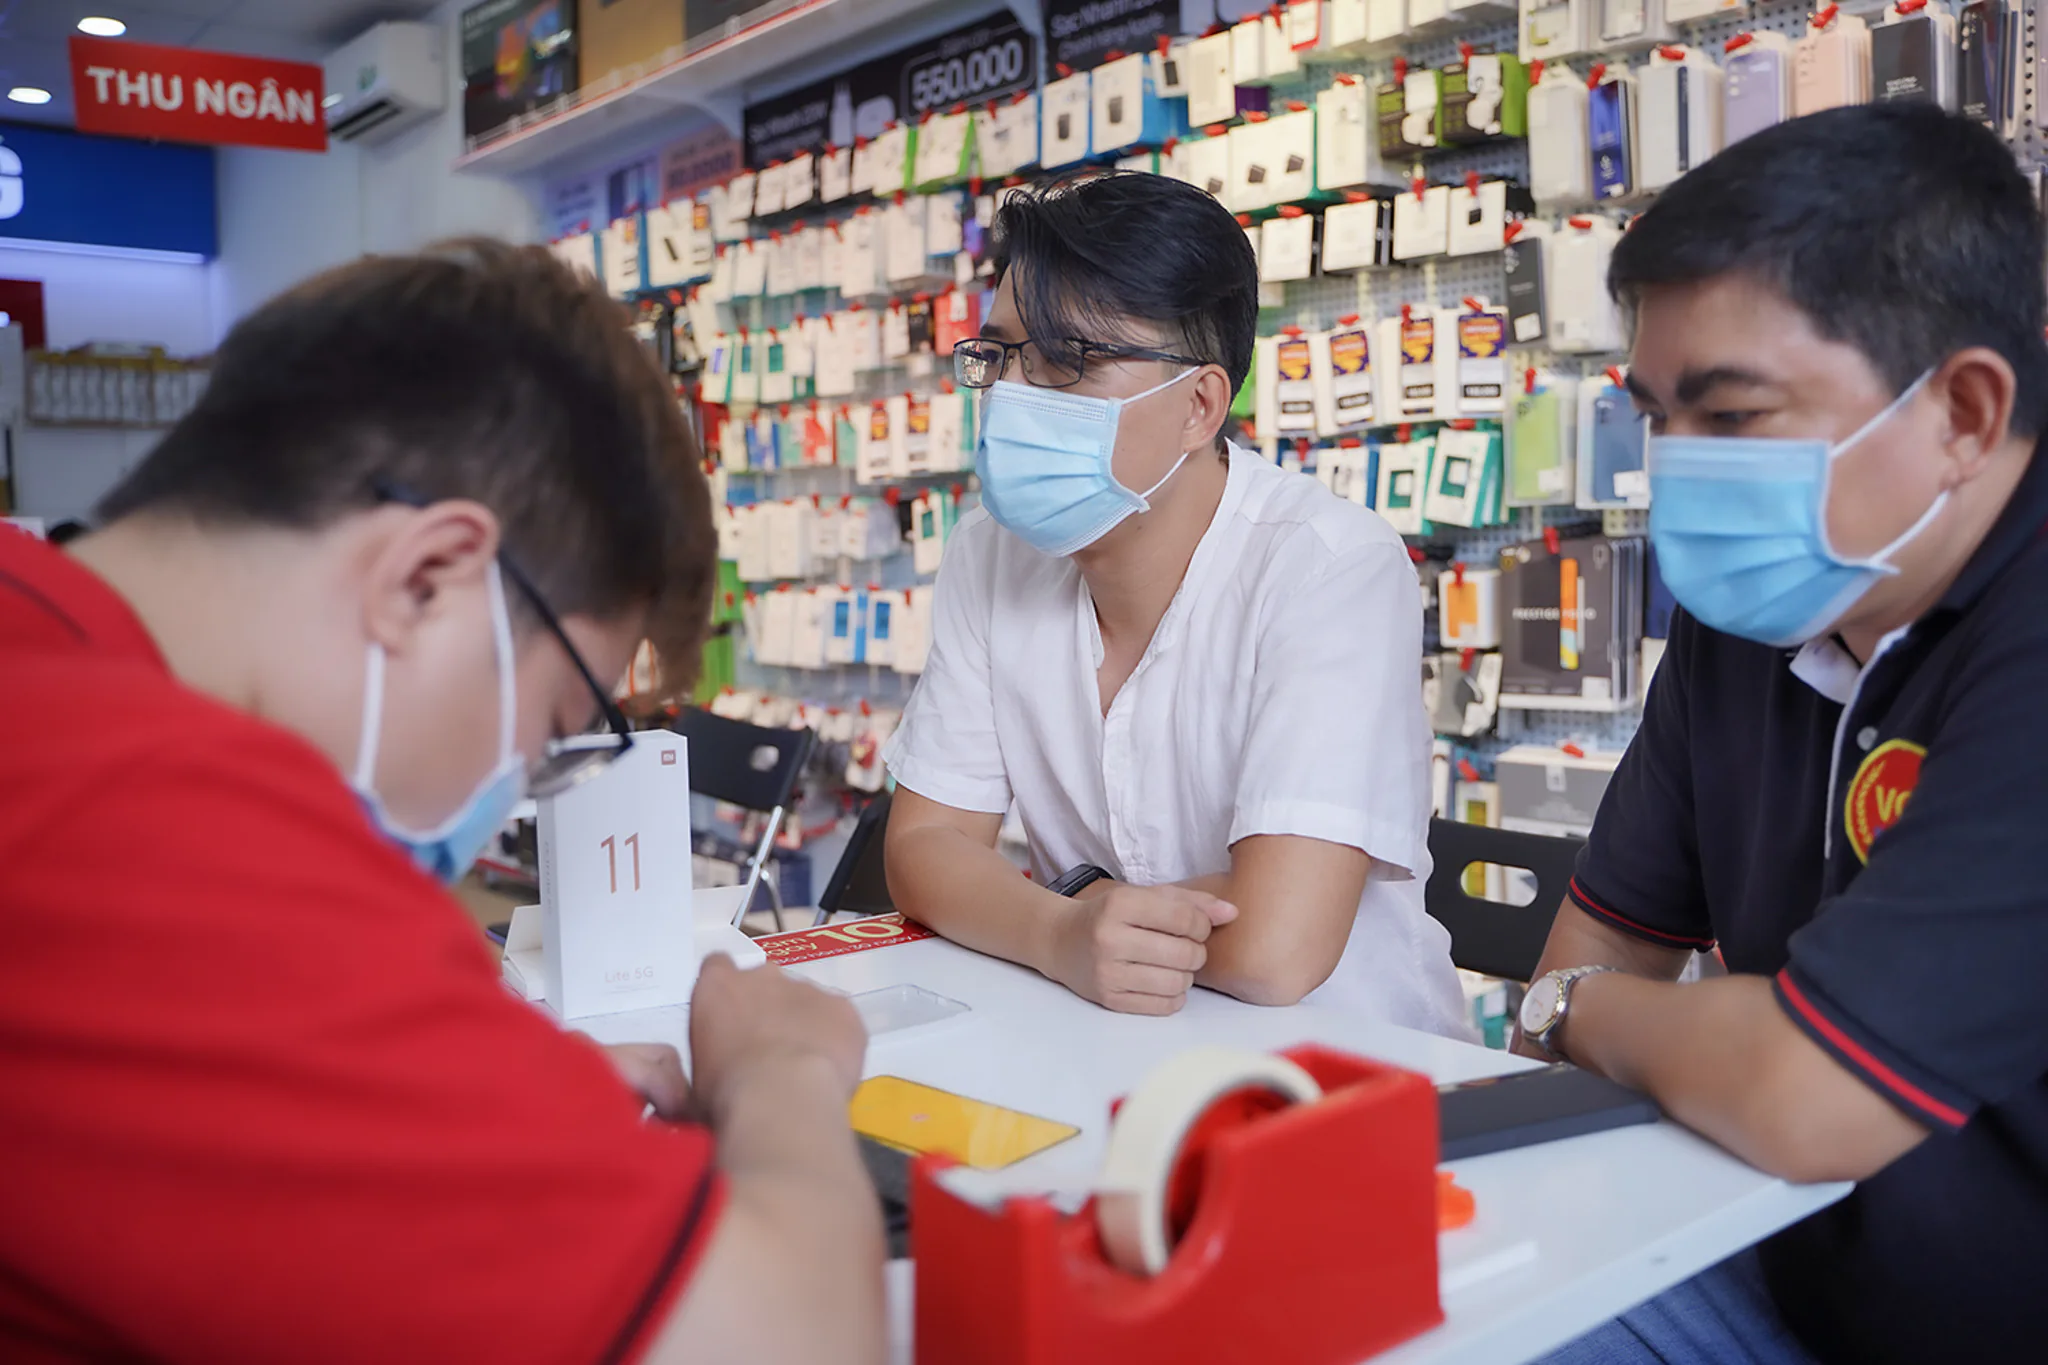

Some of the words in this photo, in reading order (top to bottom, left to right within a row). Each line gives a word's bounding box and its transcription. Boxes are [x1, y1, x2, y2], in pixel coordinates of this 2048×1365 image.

[85, 65, 184, 111] THU
[192, 77, 315, 124] NGÂN
[911, 38, 1023, 112] 550.000
[601, 832, 640, 894] 11
[605, 971, 630, 983] Lite
[634, 966, 654, 981] 5G
[766, 943, 817, 957] gay
